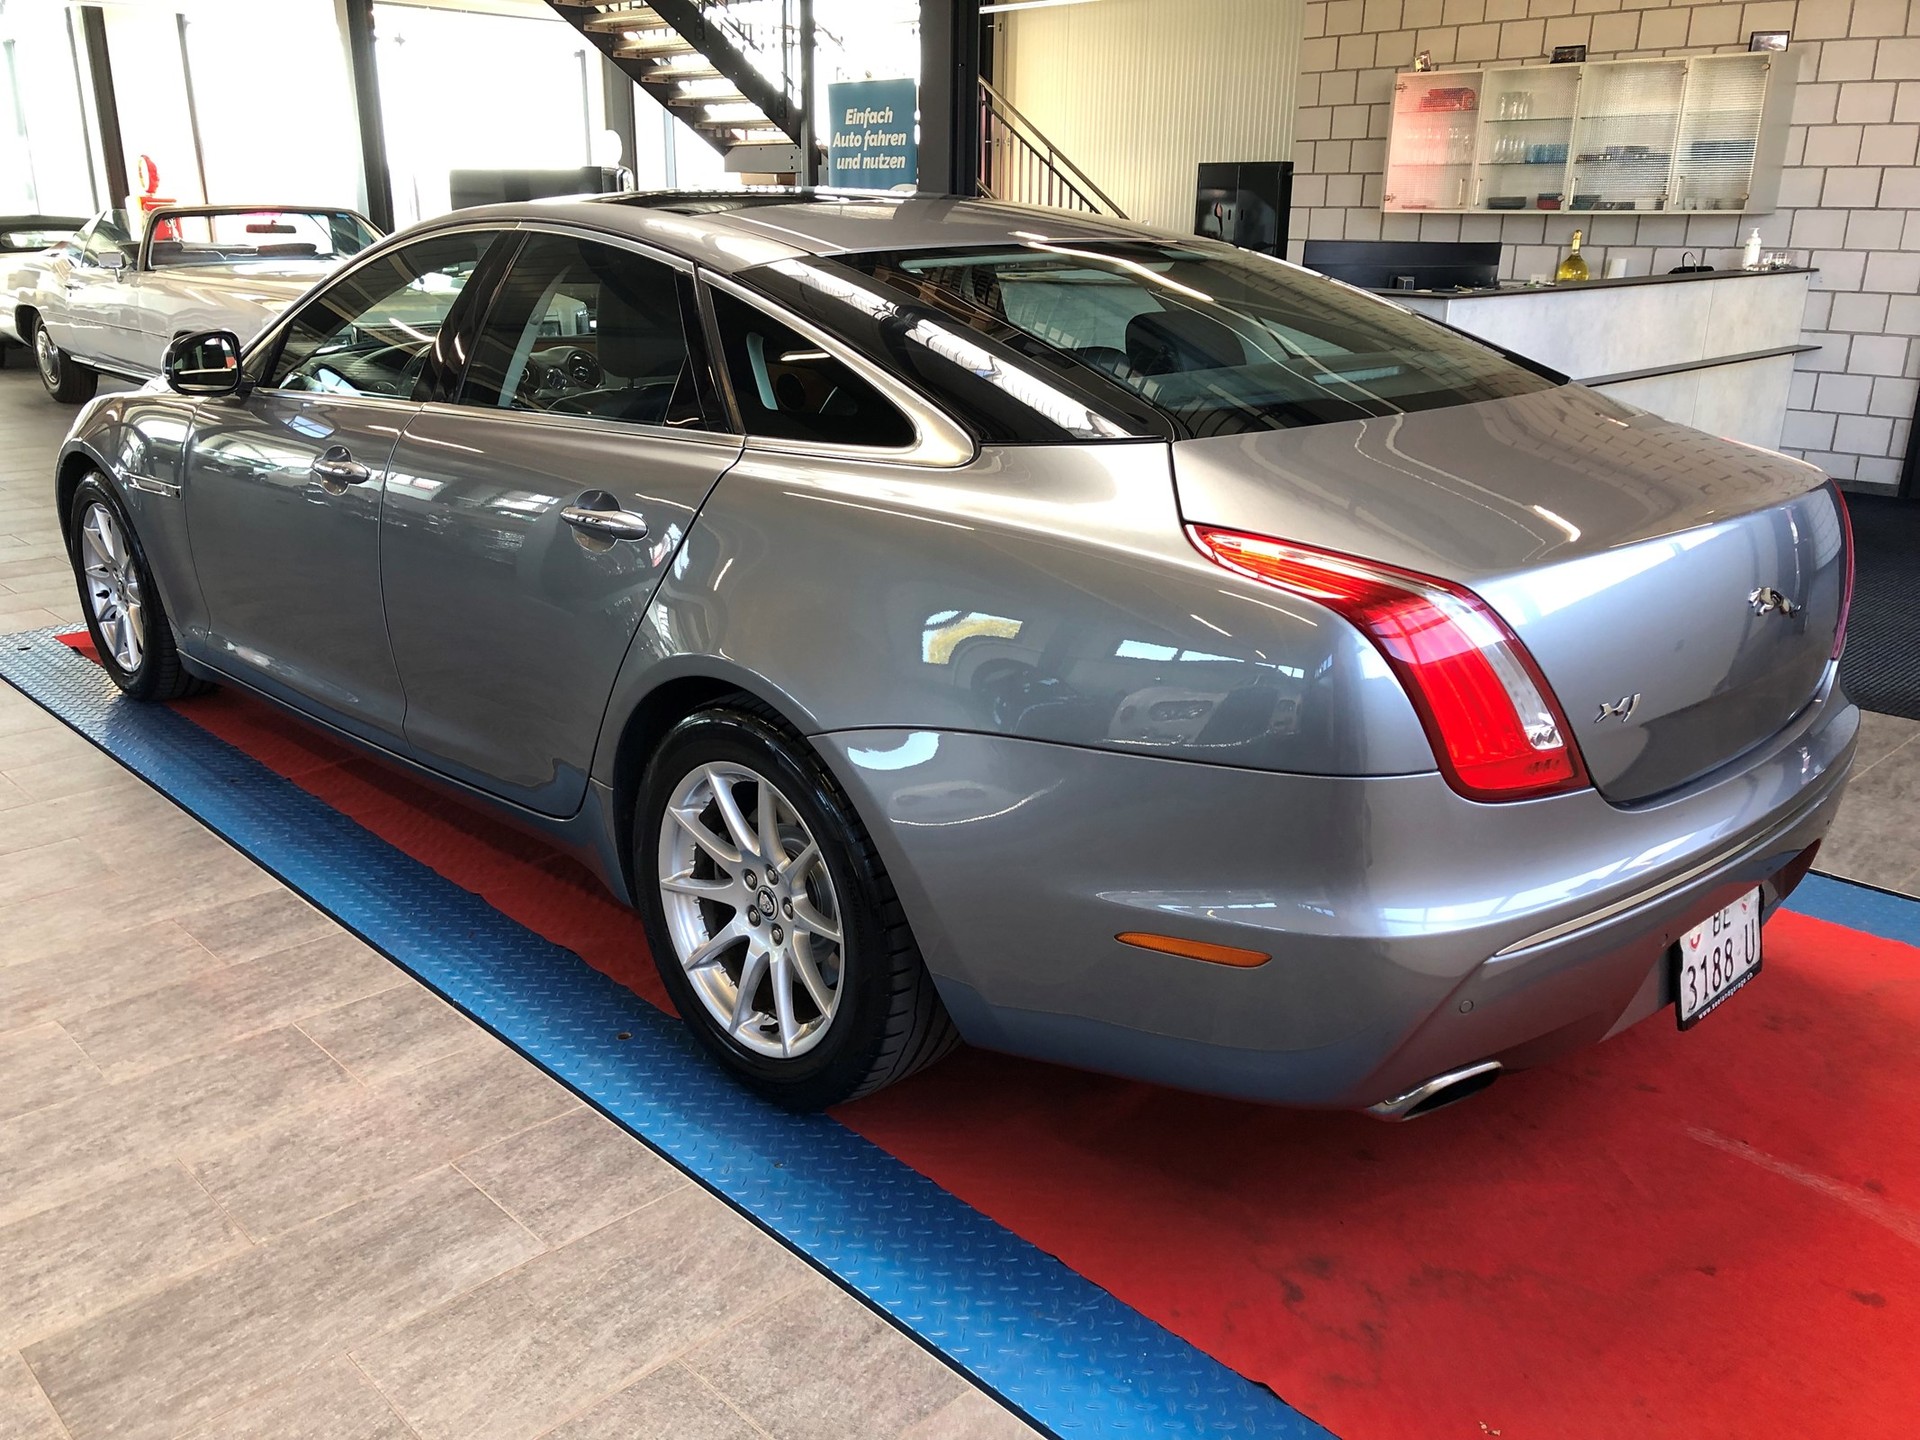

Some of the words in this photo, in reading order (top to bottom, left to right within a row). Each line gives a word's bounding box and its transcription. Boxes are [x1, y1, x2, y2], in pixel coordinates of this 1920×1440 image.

[845, 107, 893, 128] Einfach
[833, 132, 862, 147] Auto
[863, 130, 906, 151] fahren
[837, 153, 861, 169] und
[863, 153, 905, 169] nutzen
[1687, 938, 1734, 1012] 3188
[1744, 918, 1756, 964] U
